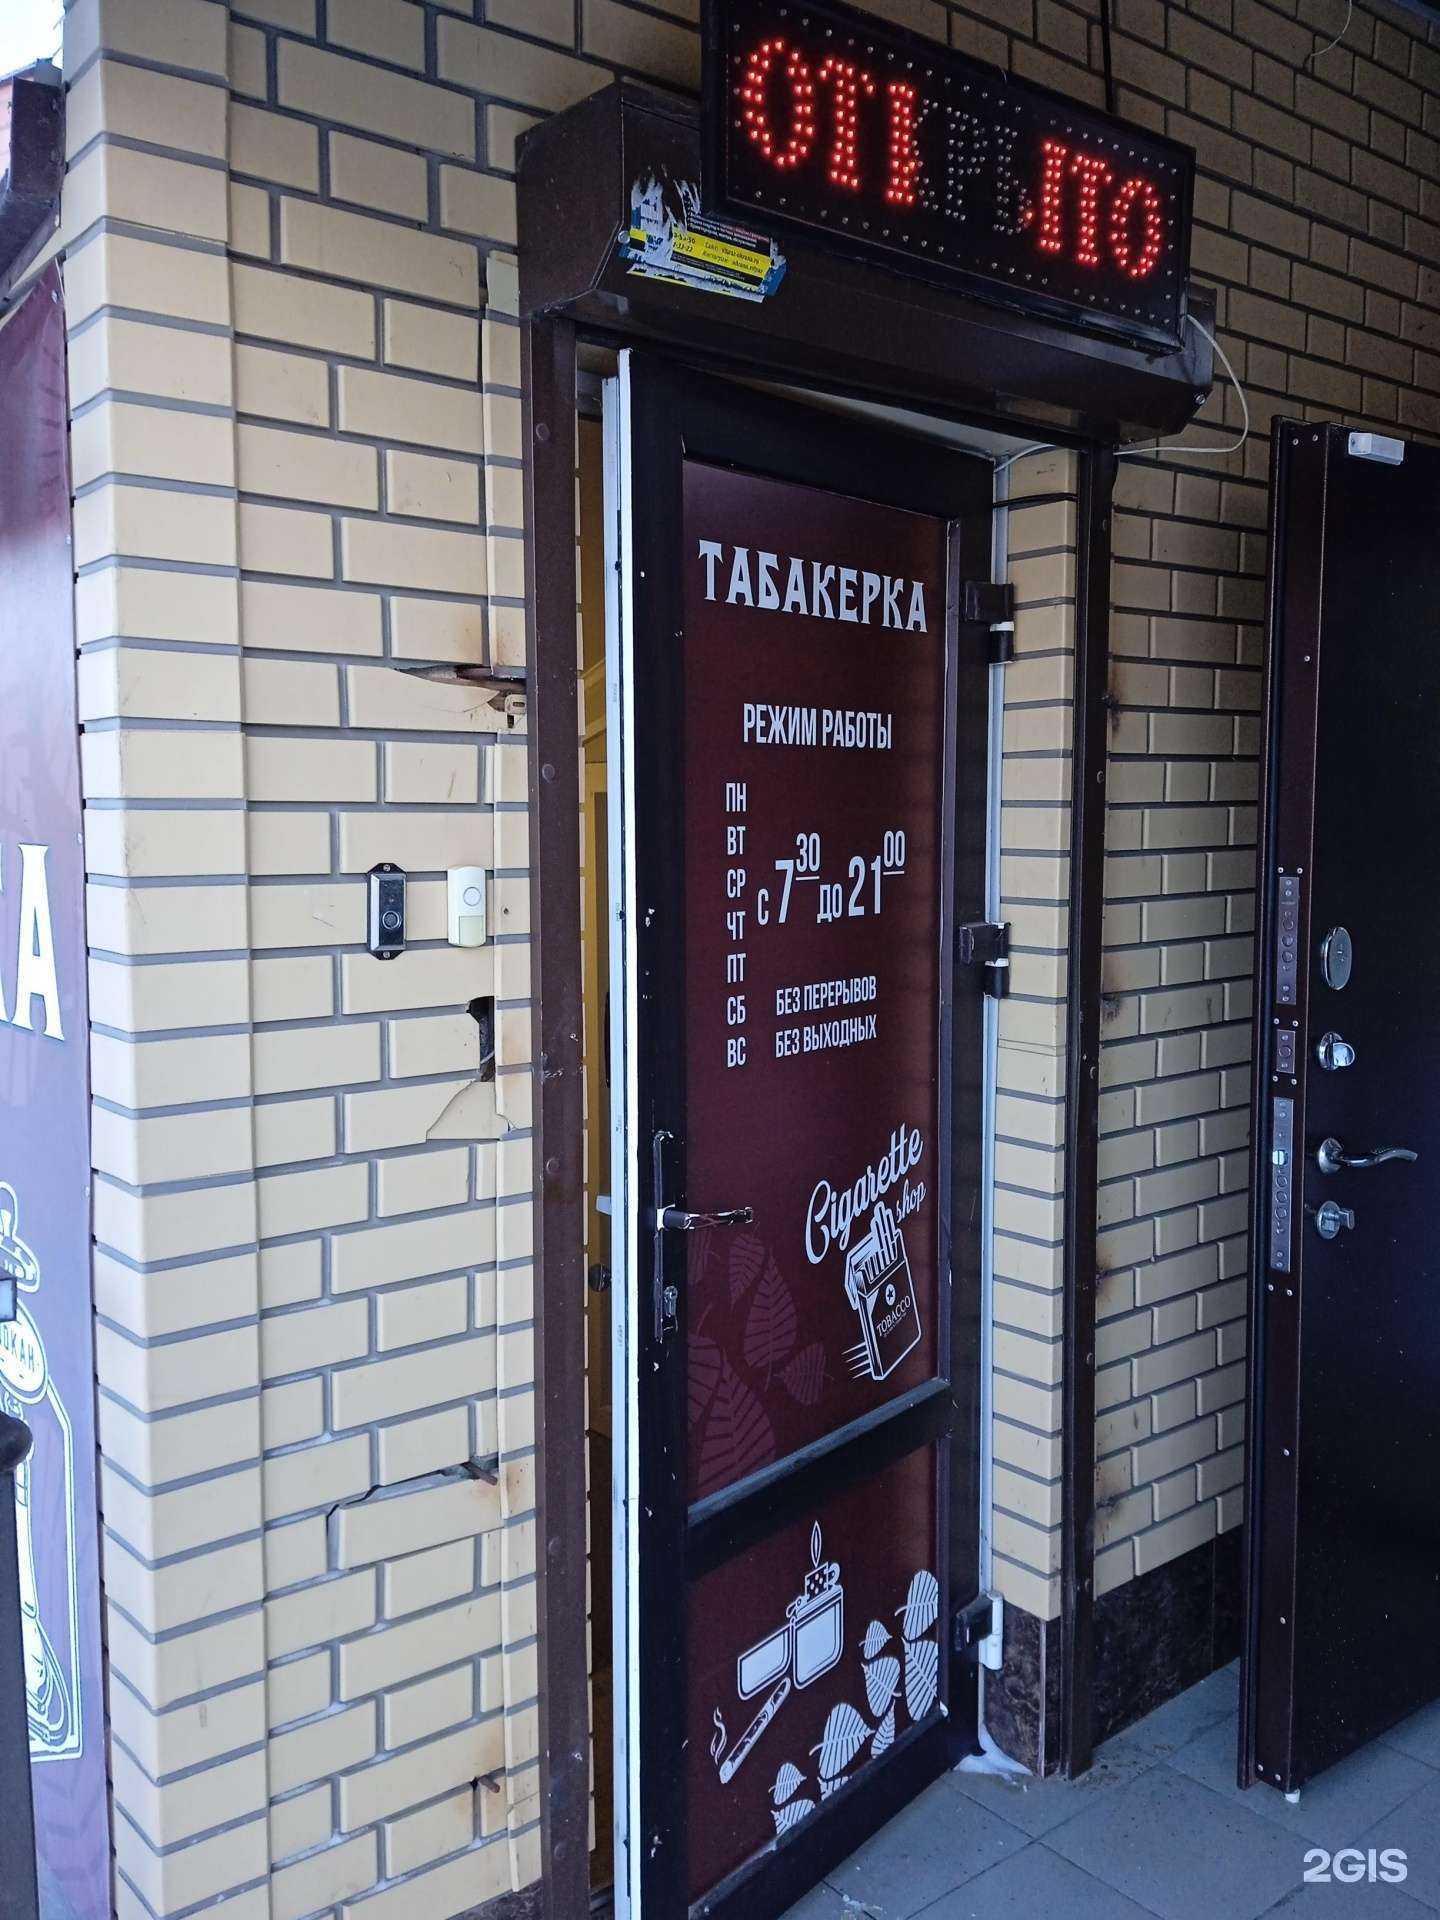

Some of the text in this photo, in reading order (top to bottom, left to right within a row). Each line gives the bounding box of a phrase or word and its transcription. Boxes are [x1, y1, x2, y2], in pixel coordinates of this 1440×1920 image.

[741, 36, 1163, 280] ОТКРЫТО
[698, 538, 928, 633] ТАБАКЕРКА
[743, 702, 892, 749] РЕЖИМ РАБОТЫ
[725, 782, 747, 812] ПН
[727, 826, 746, 855] ВТ
[726, 868, 746, 898] СР
[726, 911, 746, 940] ЧТ
[727, 953, 747, 984] ПТ
[726, 995, 746, 1026] СБ
[776, 975, 877, 1016] БЕЗ ПЕРЕРЫВОВ
[727, 1037, 746, 1068] ВС
[775, 1014, 877, 1058] БЕЗ ВЫХОДНЫХ
[805, 1122, 924, 1264] Cigarette
[896, 1178, 926, 1223] shop
[876, 1295, 910, 1337] TOBACCO
[0, 1324, 35, 1374] OKAH
